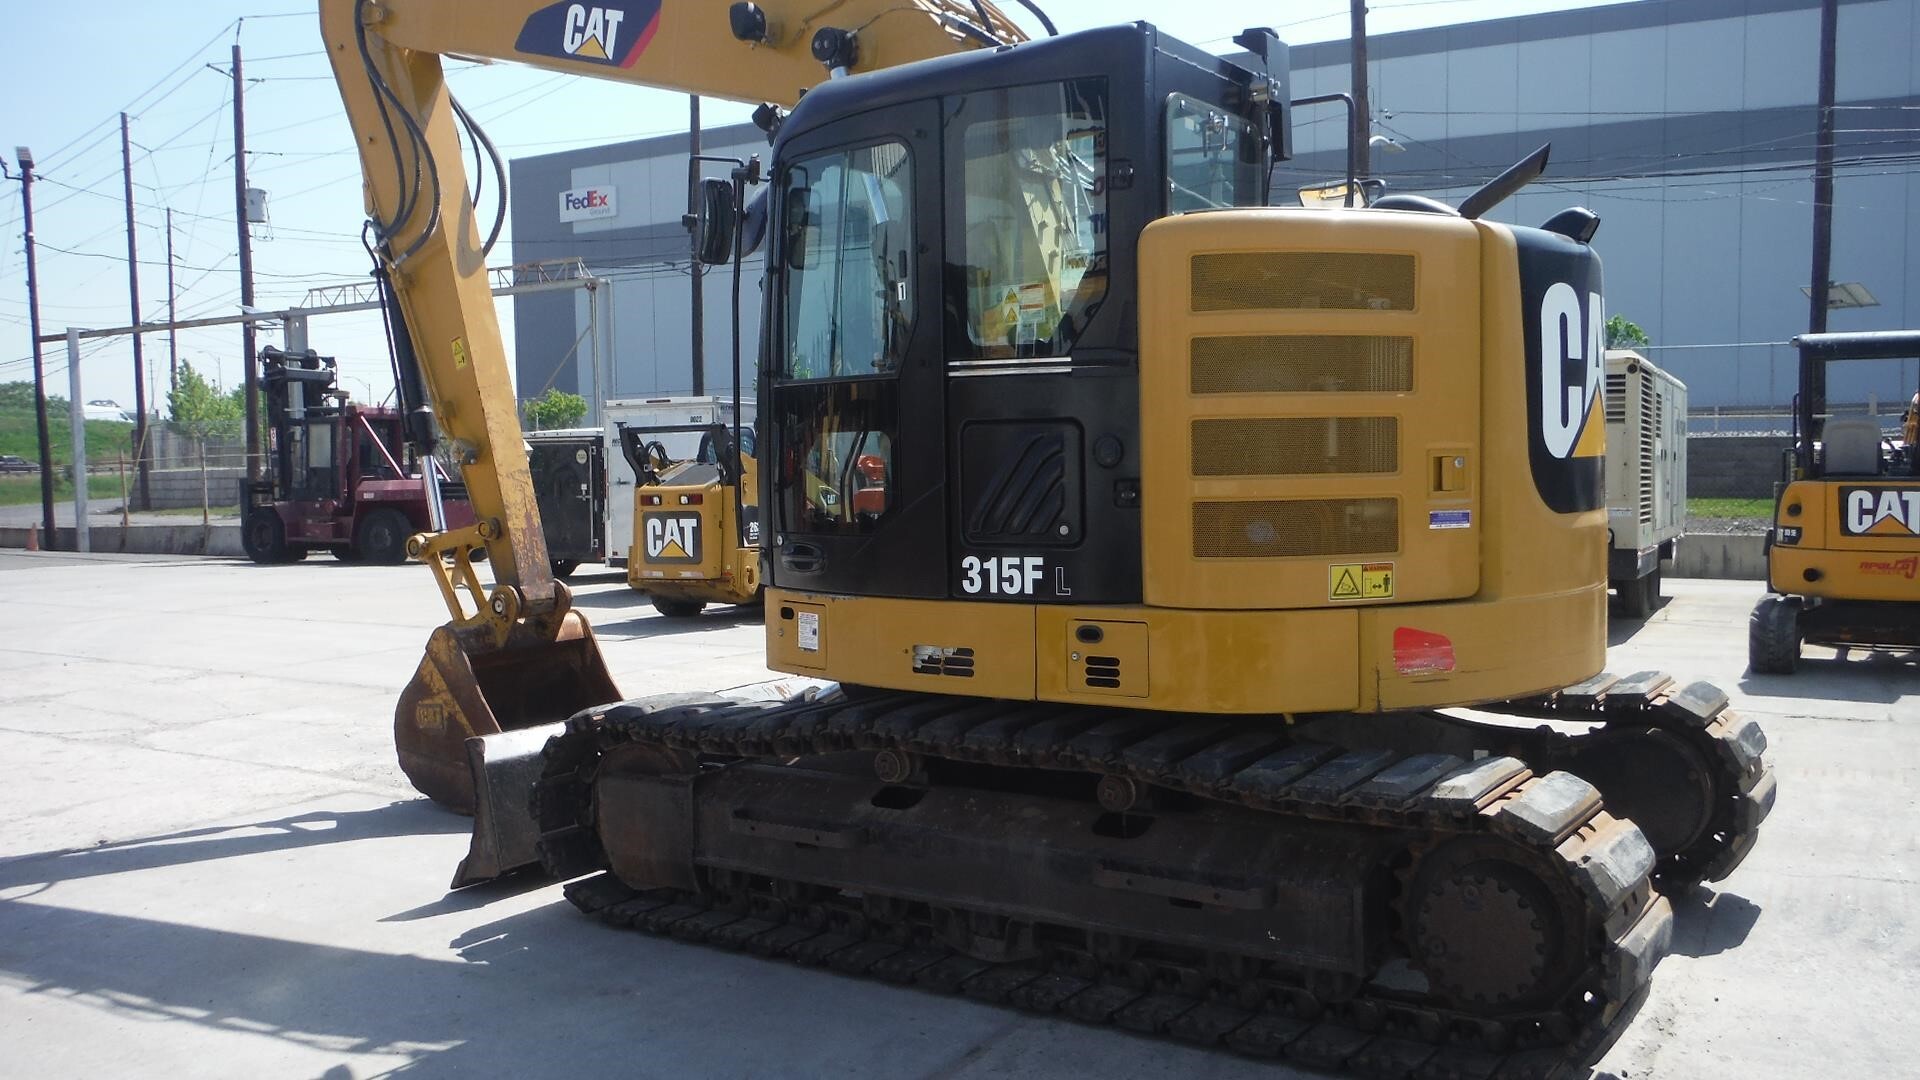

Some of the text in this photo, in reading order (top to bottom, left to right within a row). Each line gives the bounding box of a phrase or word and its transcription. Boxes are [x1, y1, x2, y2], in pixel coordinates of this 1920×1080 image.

[563, 4, 624, 60] CAT
[566, 190, 608, 211] FedEx
[1541, 282, 1605, 459] CA
[1847, 490, 1920, 534] CAT
[646, 518, 697, 557] CAT
[962, 556, 1071, 595] 315F L
